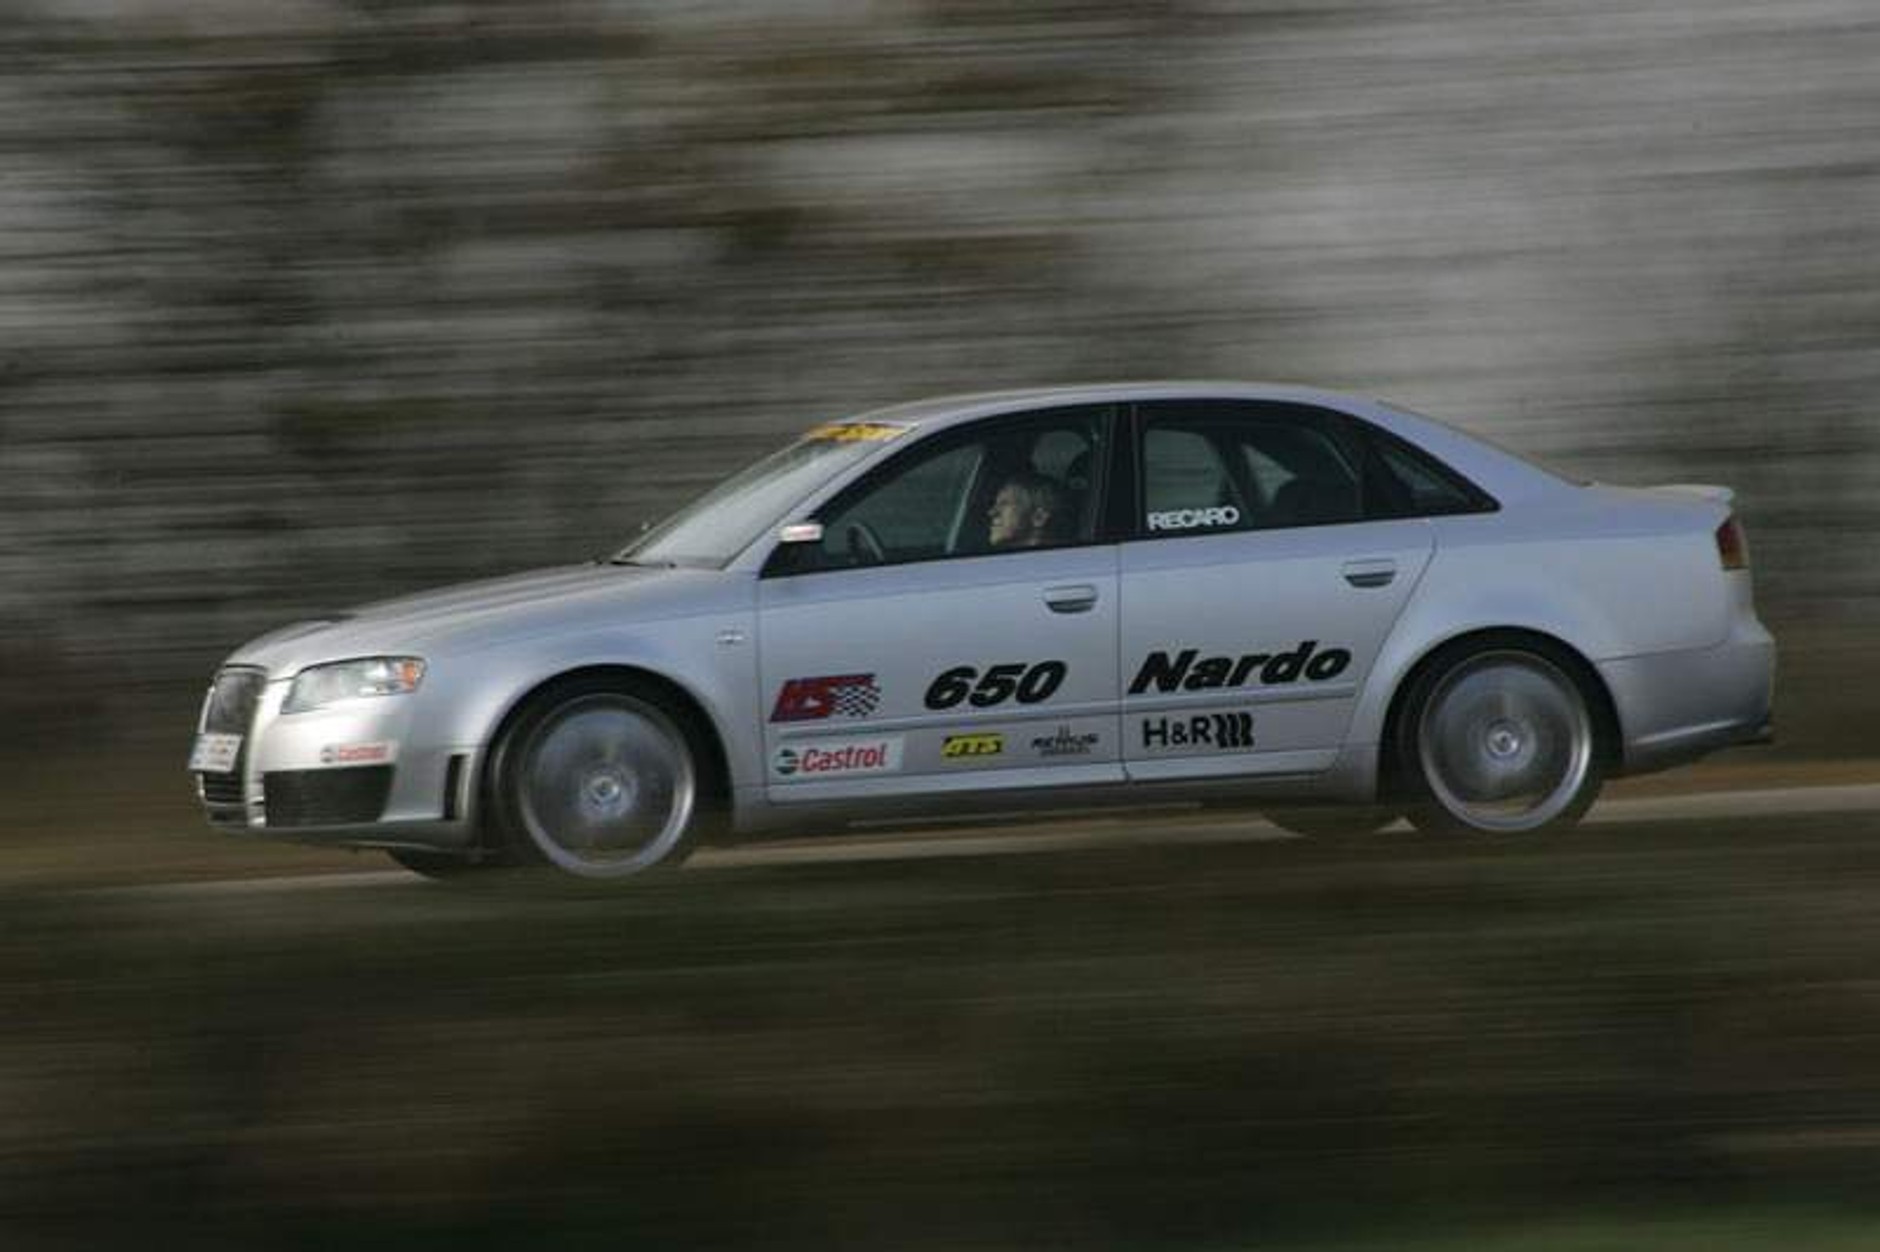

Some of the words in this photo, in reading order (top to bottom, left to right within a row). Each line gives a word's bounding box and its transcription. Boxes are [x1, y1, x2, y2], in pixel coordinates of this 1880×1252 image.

[1147, 506, 1240, 530] RECARO
[924, 660, 1067, 710] 650
[1128, 640, 1352, 695] Nardo
[1142, 712, 1212, 748] H&R
[802, 743, 888, 773] Castrol
